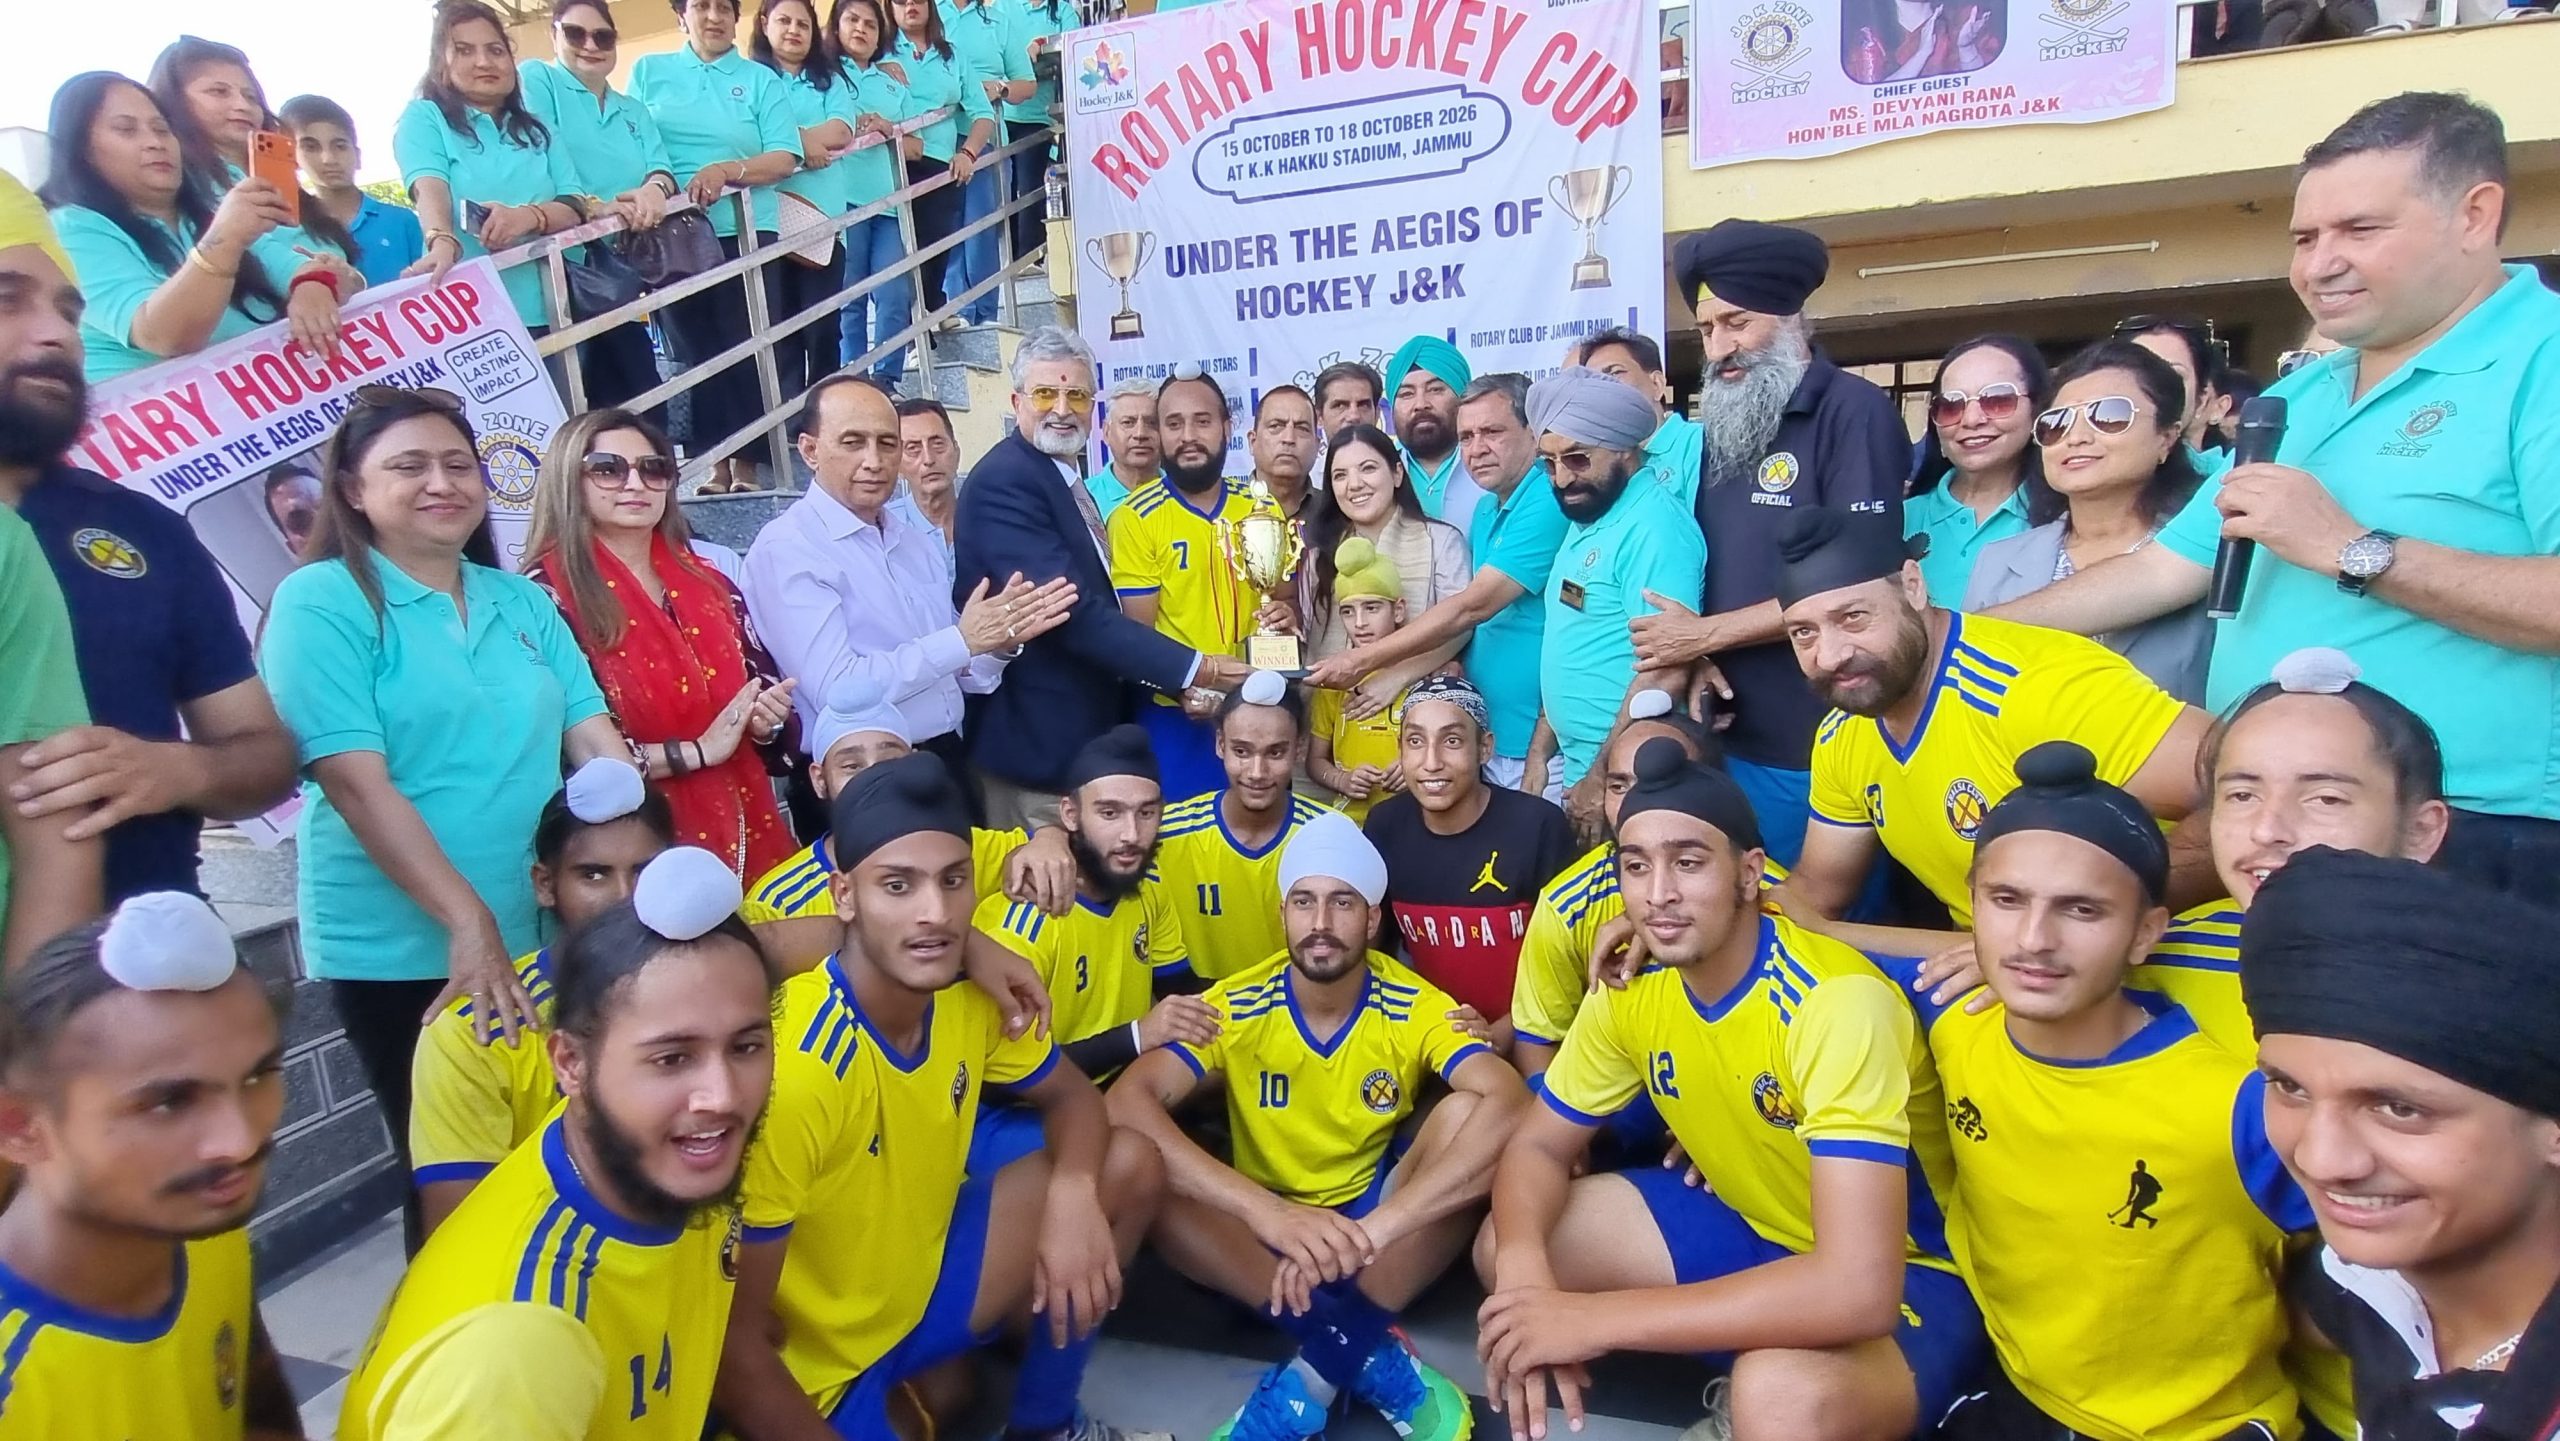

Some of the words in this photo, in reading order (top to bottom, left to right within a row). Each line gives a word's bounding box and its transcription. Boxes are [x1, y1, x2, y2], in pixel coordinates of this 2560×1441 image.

[1773, 1, 1814, 28] ZONE
[2040, 38, 2127, 61] HOCKEY
[1080, 94, 1112, 107] Hockey
[1114, 90, 1133, 104] J&K
[1091, 21, 1273, 201] ROTARY
[1294, 0, 1528, 85] HOCKEY
[1522, 32, 1639, 144] CUP
[1732, 81, 1809, 104] HOCKEY
[1829, 106, 1864, 121] MS.
[1873, 92, 1955, 116] DEVYANI
[1962, 85, 2016, 104] RANA
[1873, 83, 1917, 98] CHIEF
[1922, 76, 1971, 91] GUEST
[1222, 141, 1239, 157] 15
[1243, 129, 1310, 154] OCTOBER
[1315, 126, 1334, 143] TO
[1339, 123, 1357, 140] 18
[1362, 112, 1433, 137] OCTOBER
[1439, 104, 1477, 126] 2026
[1788, 121, 1867, 144] HON'BLE
[1873, 115, 1915, 132] MLA
[1922, 103, 2013, 126] NAGROTA
[2019, 96, 2061, 115] J&K
[1227, 164, 1244, 181] AT
[1249, 160, 1273, 179] K.K
[1279, 152, 1328, 174] HAKKU
[1333, 142, 1407, 167] STADIUM,
[1412, 131, 1472, 156] JAMMU
[1165, 234, 1279, 278] UNDER
[1289, 223, 1358, 263] THE
[1371, 206, 1480, 254] AEGIS
[1494, 197, 1543, 238] OF
[1236, 273, 1376, 321] HOCKEY
[1390, 263, 1466, 305] J&K
[1471, 329, 1506, 348] ROTARY
[1509, 327, 1533, 344] CLUB
[1536, 326, 1548, 342] OF
[1550, 320, 1585, 340] JAMMU
[452, 337, 506, 367] CREATE
[463, 349, 521, 383] LASTING
[68, 382, 221, 481] TARY
[400, 282, 482, 345] CUP
[474, 367, 522, 399] IMPACT
[1114, 365, 1143, 382] ROTARY
[1146, 363, 1167, 379] CLUB
[1213, 356, 1238, 373] STARS
[150, 452, 231, 500] UNDER
[221, 433, 272, 467] THE
[265, 409, 326, 452] AEGIS
[320, 397, 346, 426] OF
[408, 356, 447, 388] J&K
[482, 412, 548, 440] ZONE
[1751, 492, 1793, 507] OFFICIAL
[1172, 541, 1189, 571] 7
[1254, 655, 1297, 666] WINNER
[1197, 884, 1222, 915] 11
[1076, 953, 1088, 993] 3
[1259, 1071, 1289, 1108] 10
[1649, 1051, 1680, 1099] 12
[630, 1330, 673, 1422] 14
